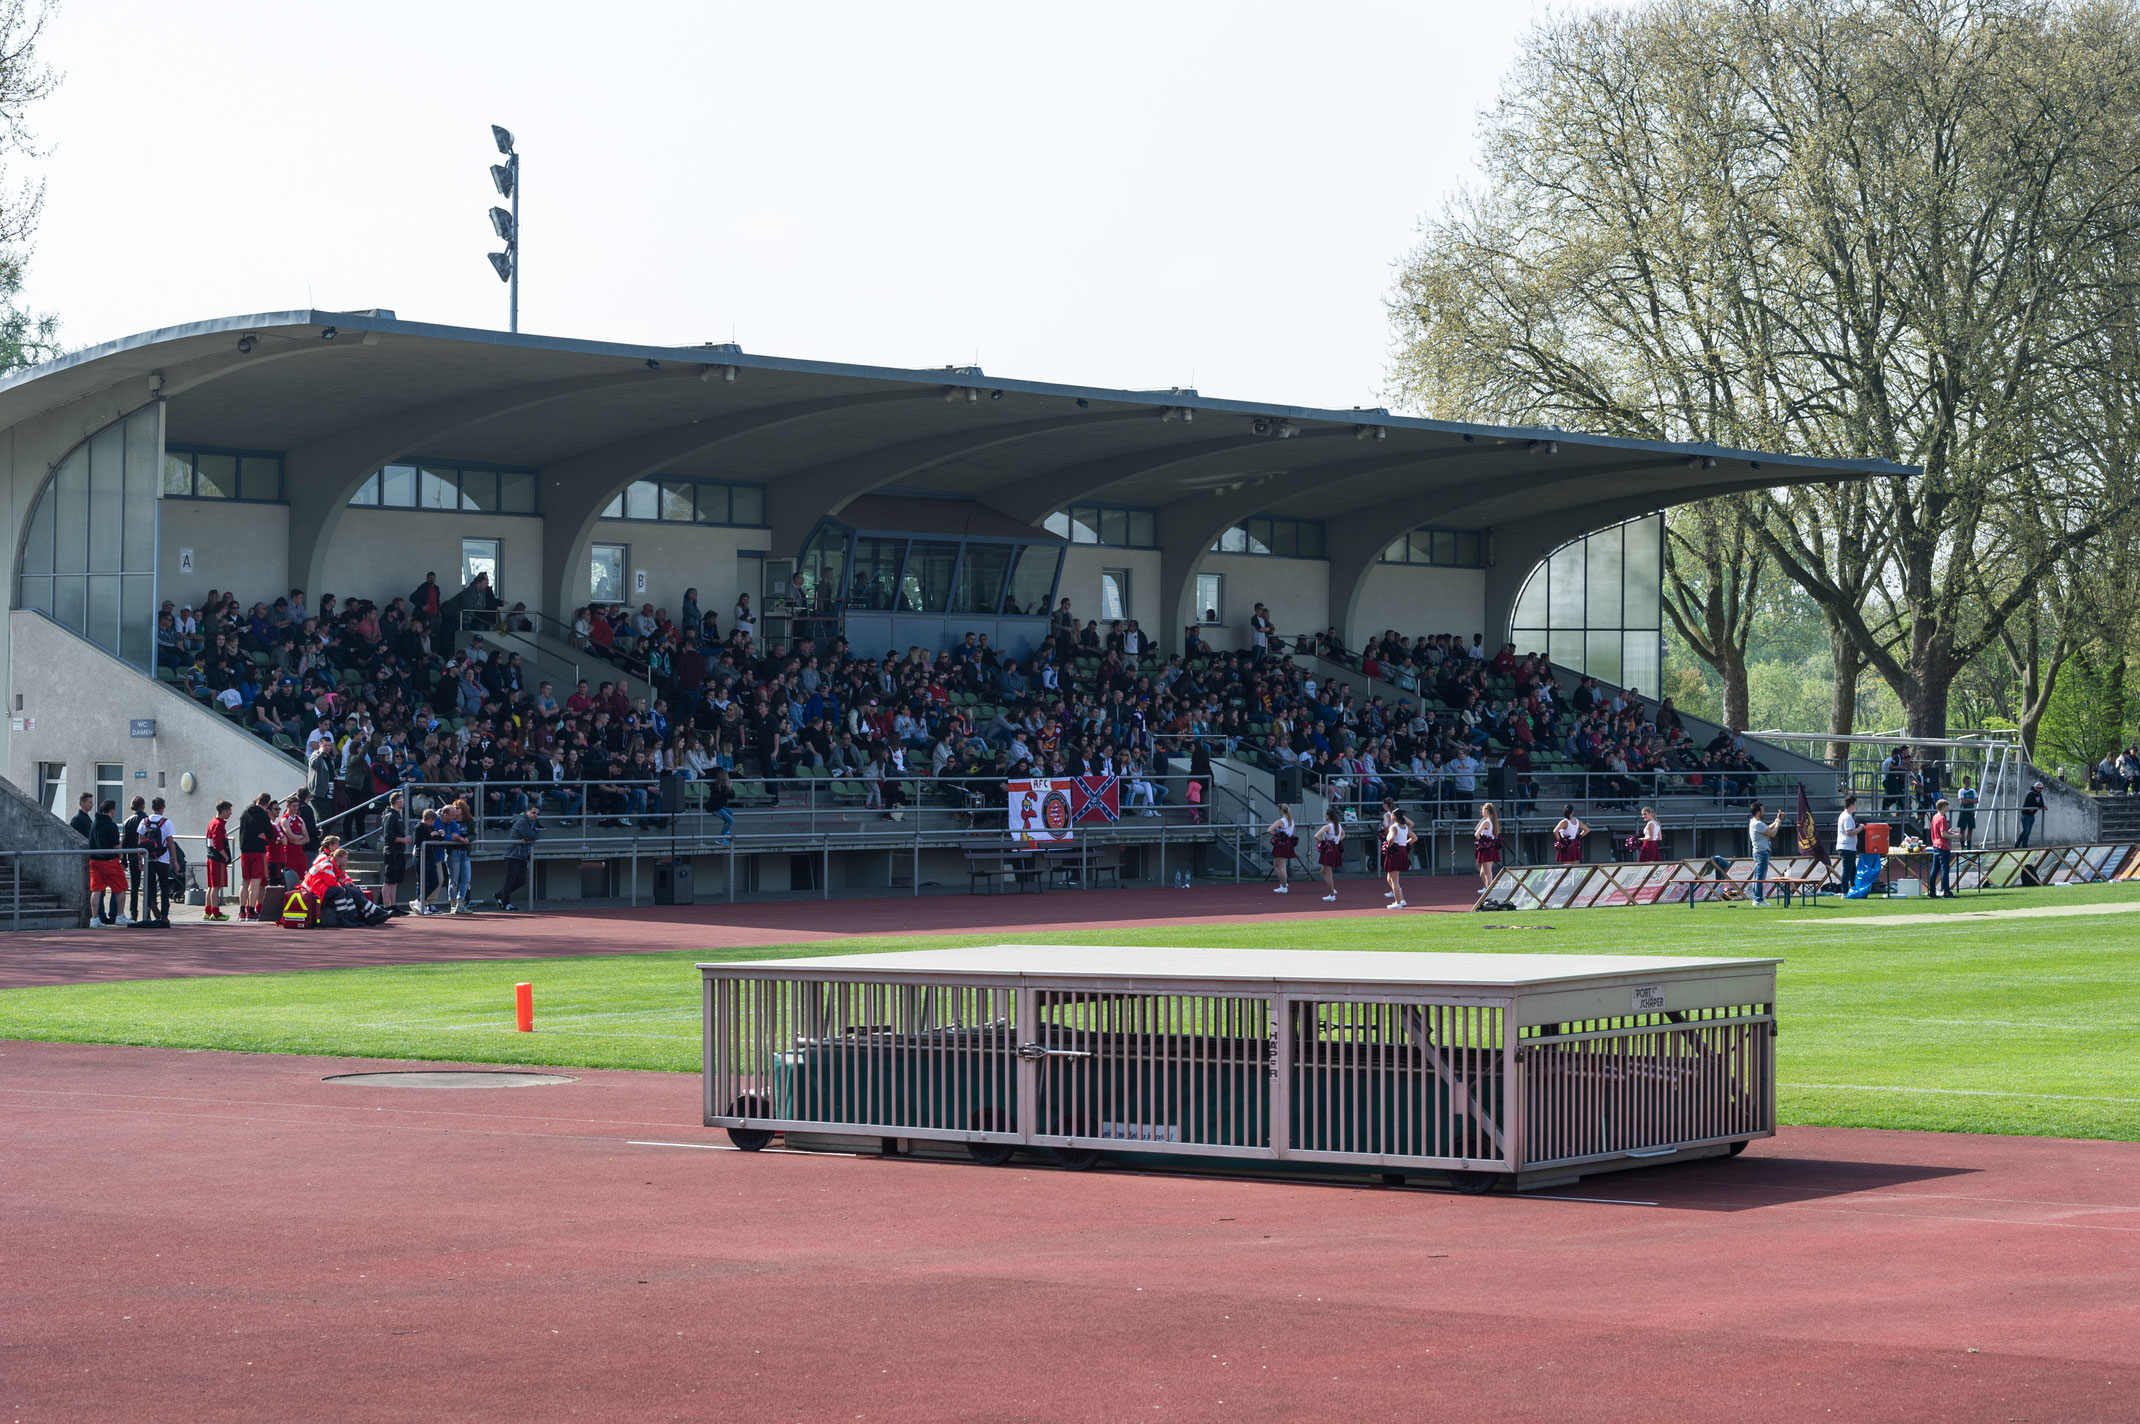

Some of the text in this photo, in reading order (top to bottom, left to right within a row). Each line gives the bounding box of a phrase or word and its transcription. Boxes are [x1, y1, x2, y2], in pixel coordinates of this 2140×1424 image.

[182, 554, 191, 568] A
[637, 574, 645, 588] B
[1033, 779, 1049, 789] AFC
